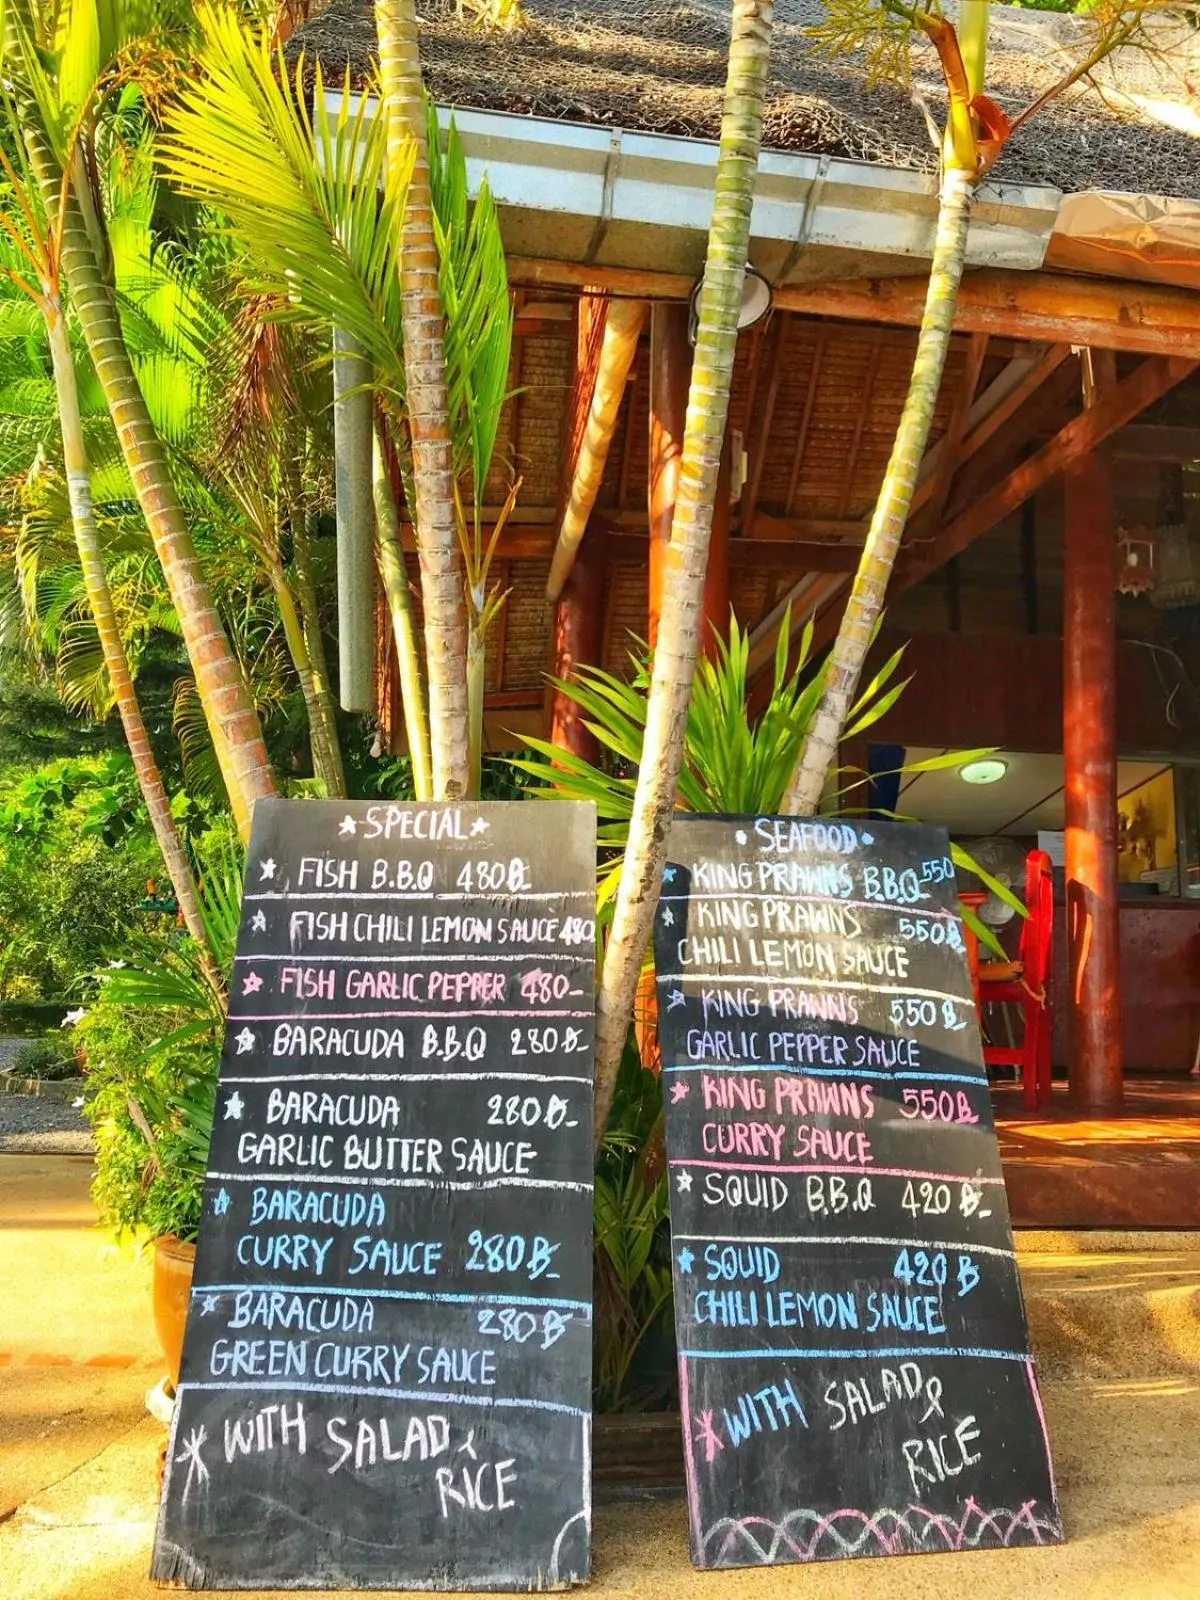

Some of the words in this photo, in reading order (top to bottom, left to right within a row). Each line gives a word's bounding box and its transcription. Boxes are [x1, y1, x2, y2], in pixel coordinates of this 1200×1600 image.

[364, 805, 469, 840] SPECIAL
[754, 817, 859, 854] SEAFOOD
[298, 857, 357, 889] FISH
[371, 858, 433, 891] B.B.Q
[691, 862, 752, 890] KING
[756, 861, 853, 898] PRAWNS
[863, 866, 931, 903] B.B.Q
[919, 856, 955, 883] 550
[290, 911, 348, 943] FISH
[353, 912, 412, 944] CHILI
[422, 916, 492, 944] LEMON
[498, 918, 559, 944] SAUCE
[697, 900, 759, 930] KING
[761, 900, 863, 939] PRAWNS
[677, 936, 740, 966] CHILI
[748, 938, 837, 974] LEMON
[842, 944, 911, 978] SAUCE
[281, 967, 335, 1000] FISH
[345, 969, 425, 1001] GARLIC
[428, 971, 506, 1003] PEPPER
[701, 988, 760, 1019] KING
[768, 988, 860, 1025] PRAWNS
[272, 1023, 404, 1059] BARACUDA
[421, 1024, 487, 1061] B.B.Q
[686, 1028, 759, 1062] GARLIC
[768, 1031, 849, 1065] PEPPER
[851, 1035, 920, 1068] SAUCE
[266, 1088, 400, 1128] BARACUDA
[702, 1074, 766, 1111] KING
[774, 1077, 876, 1120] PRAWNS
[237, 1132, 334, 1168] GARLIC
[343, 1134, 442, 1174] BUTTER
[451, 1137, 537, 1175] SAUCE
[702, 1122, 786, 1161] CURRY
[793, 1123, 875, 1165] SAUCE
[249, 1186, 385, 1227] BARACUDA
[702, 1172, 789, 1212] SQUID
[805, 1175, 876, 1216] B.B.Q
[236, 1234, 334, 1276] CURRY
[348, 1235, 442, 1276] SAUCE
[704, 1243, 780, 1283] SQUID
[227, 1290, 374, 1333] BARACUDA
[694, 1289, 759, 1328] CHILI
[767, 1291, 858, 1331] LEMON
[866, 1294, 946, 1335] SAUCE
[210, 1338, 307, 1378] GREEN
[314, 1342, 410, 1384] CURRY
[416, 1346, 496, 1385] SAUCE
[722, 1377, 809, 1448] WITH
[823, 1361, 924, 1430] SALAD
[223, 1402, 307, 1463] WITH
[326, 1414, 450, 1475] SALAD
[901, 1414, 981, 1498] RICE
[435, 1457, 518, 1519] RICE
